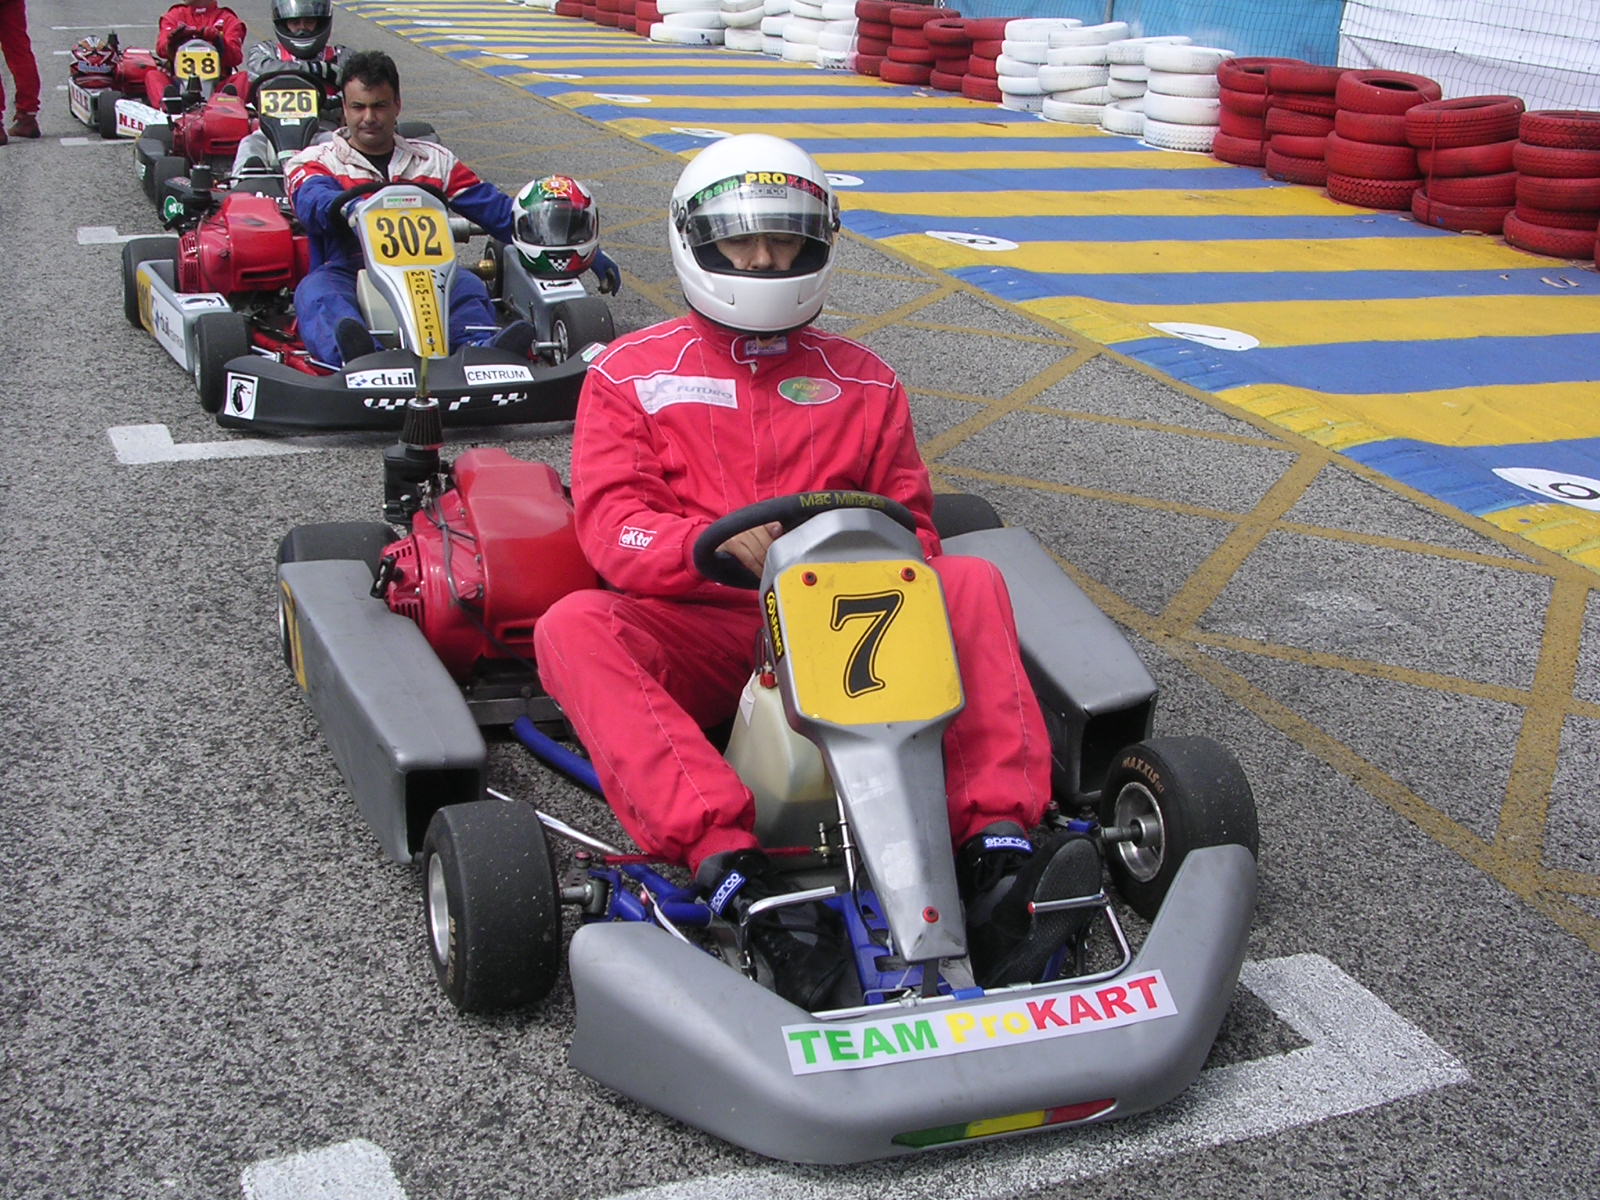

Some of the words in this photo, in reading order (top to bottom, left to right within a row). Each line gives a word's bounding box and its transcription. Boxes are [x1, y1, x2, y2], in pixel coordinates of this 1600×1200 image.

[182, 57, 216, 74] 38
[264, 91, 312, 113] 326
[694, 178, 740, 205] Team
[376, 215, 443, 259] 302
[371, 372, 414, 386] duil
[467, 370, 526, 381] CENTRUM
[800, 492, 832, 508] Mac
[830, 589, 904, 699] 7
[788, 1019, 939, 1065] TEAM
